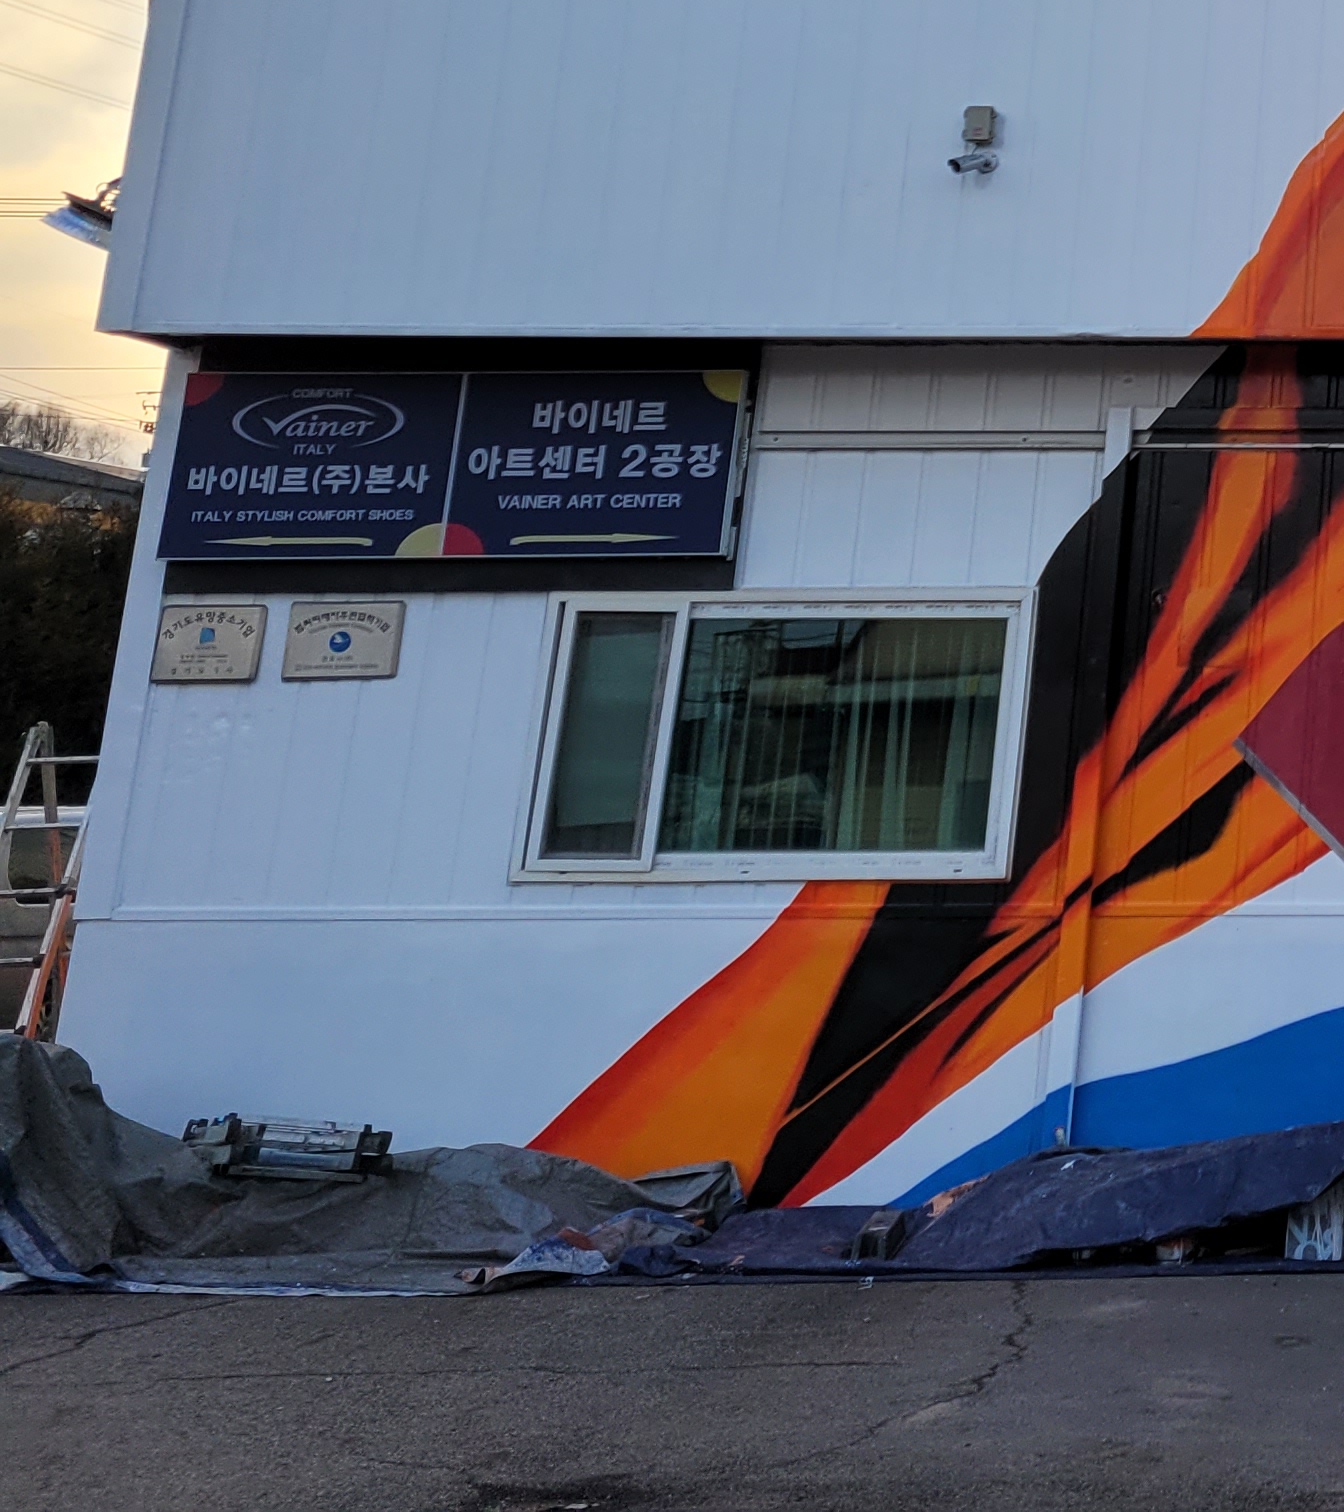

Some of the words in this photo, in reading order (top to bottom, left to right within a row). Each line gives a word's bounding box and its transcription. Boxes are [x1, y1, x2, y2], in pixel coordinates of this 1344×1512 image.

[292, 388, 354, 399] COMFORT
[261, 403, 377, 438] Vainer
[532, 399, 669, 435] 바이네르
[292, 443, 337, 456] ITALY
[467, 444, 607, 481] 아트센터
[618, 443, 723, 479] 2공장
[186, 463, 431, 496] 바이네르(주)본사
[497, 494, 562, 510] VAINER
[566, 494, 607, 509] ART
[609, 493, 683, 509] CENTER
[190, 510, 232, 523] ITALY
[235, 510, 294, 522] STYLISH
[296, 509, 367, 522] COMFORT
[367, 509, 415, 521] SHOES
